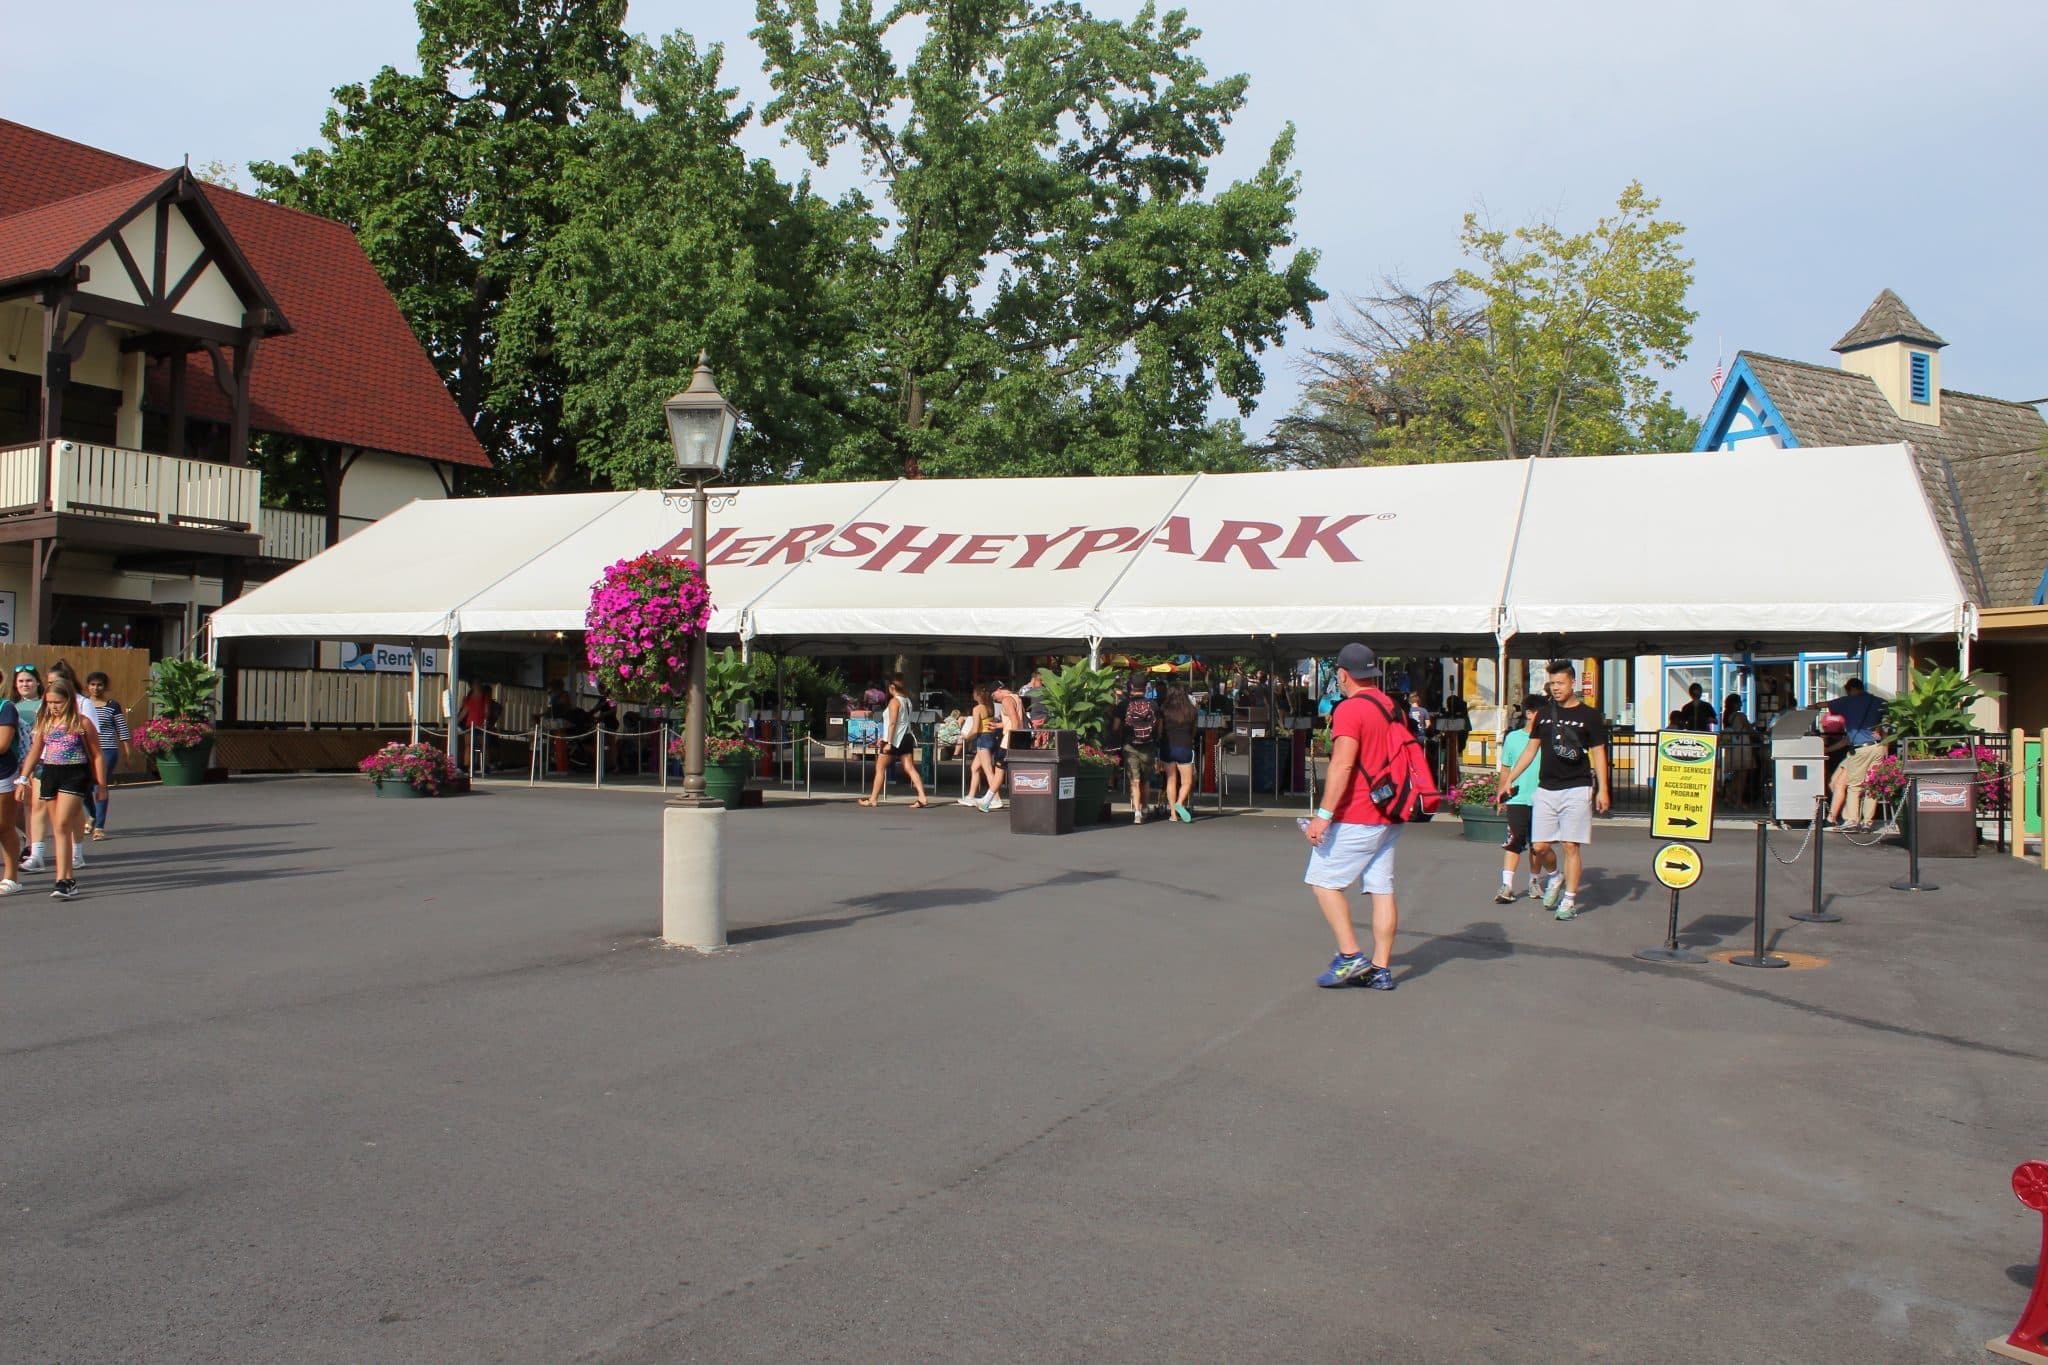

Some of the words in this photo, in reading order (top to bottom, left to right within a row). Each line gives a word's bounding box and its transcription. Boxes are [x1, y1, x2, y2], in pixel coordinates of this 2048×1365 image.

[656, 512, 1376, 574] HERSHEYPARK
[376, 648, 434, 668] Rentls
[1662, 765, 1681, 773] GUEST
[1682, 766, 1713, 775] SERVICES
[1664, 781, 1708, 790] ACCESSIBILITY
[1670, 789, 1700, 798] PROGRAM
[1663, 801, 1682, 812] Stay
[1683, 803, 1704, 813] Right
